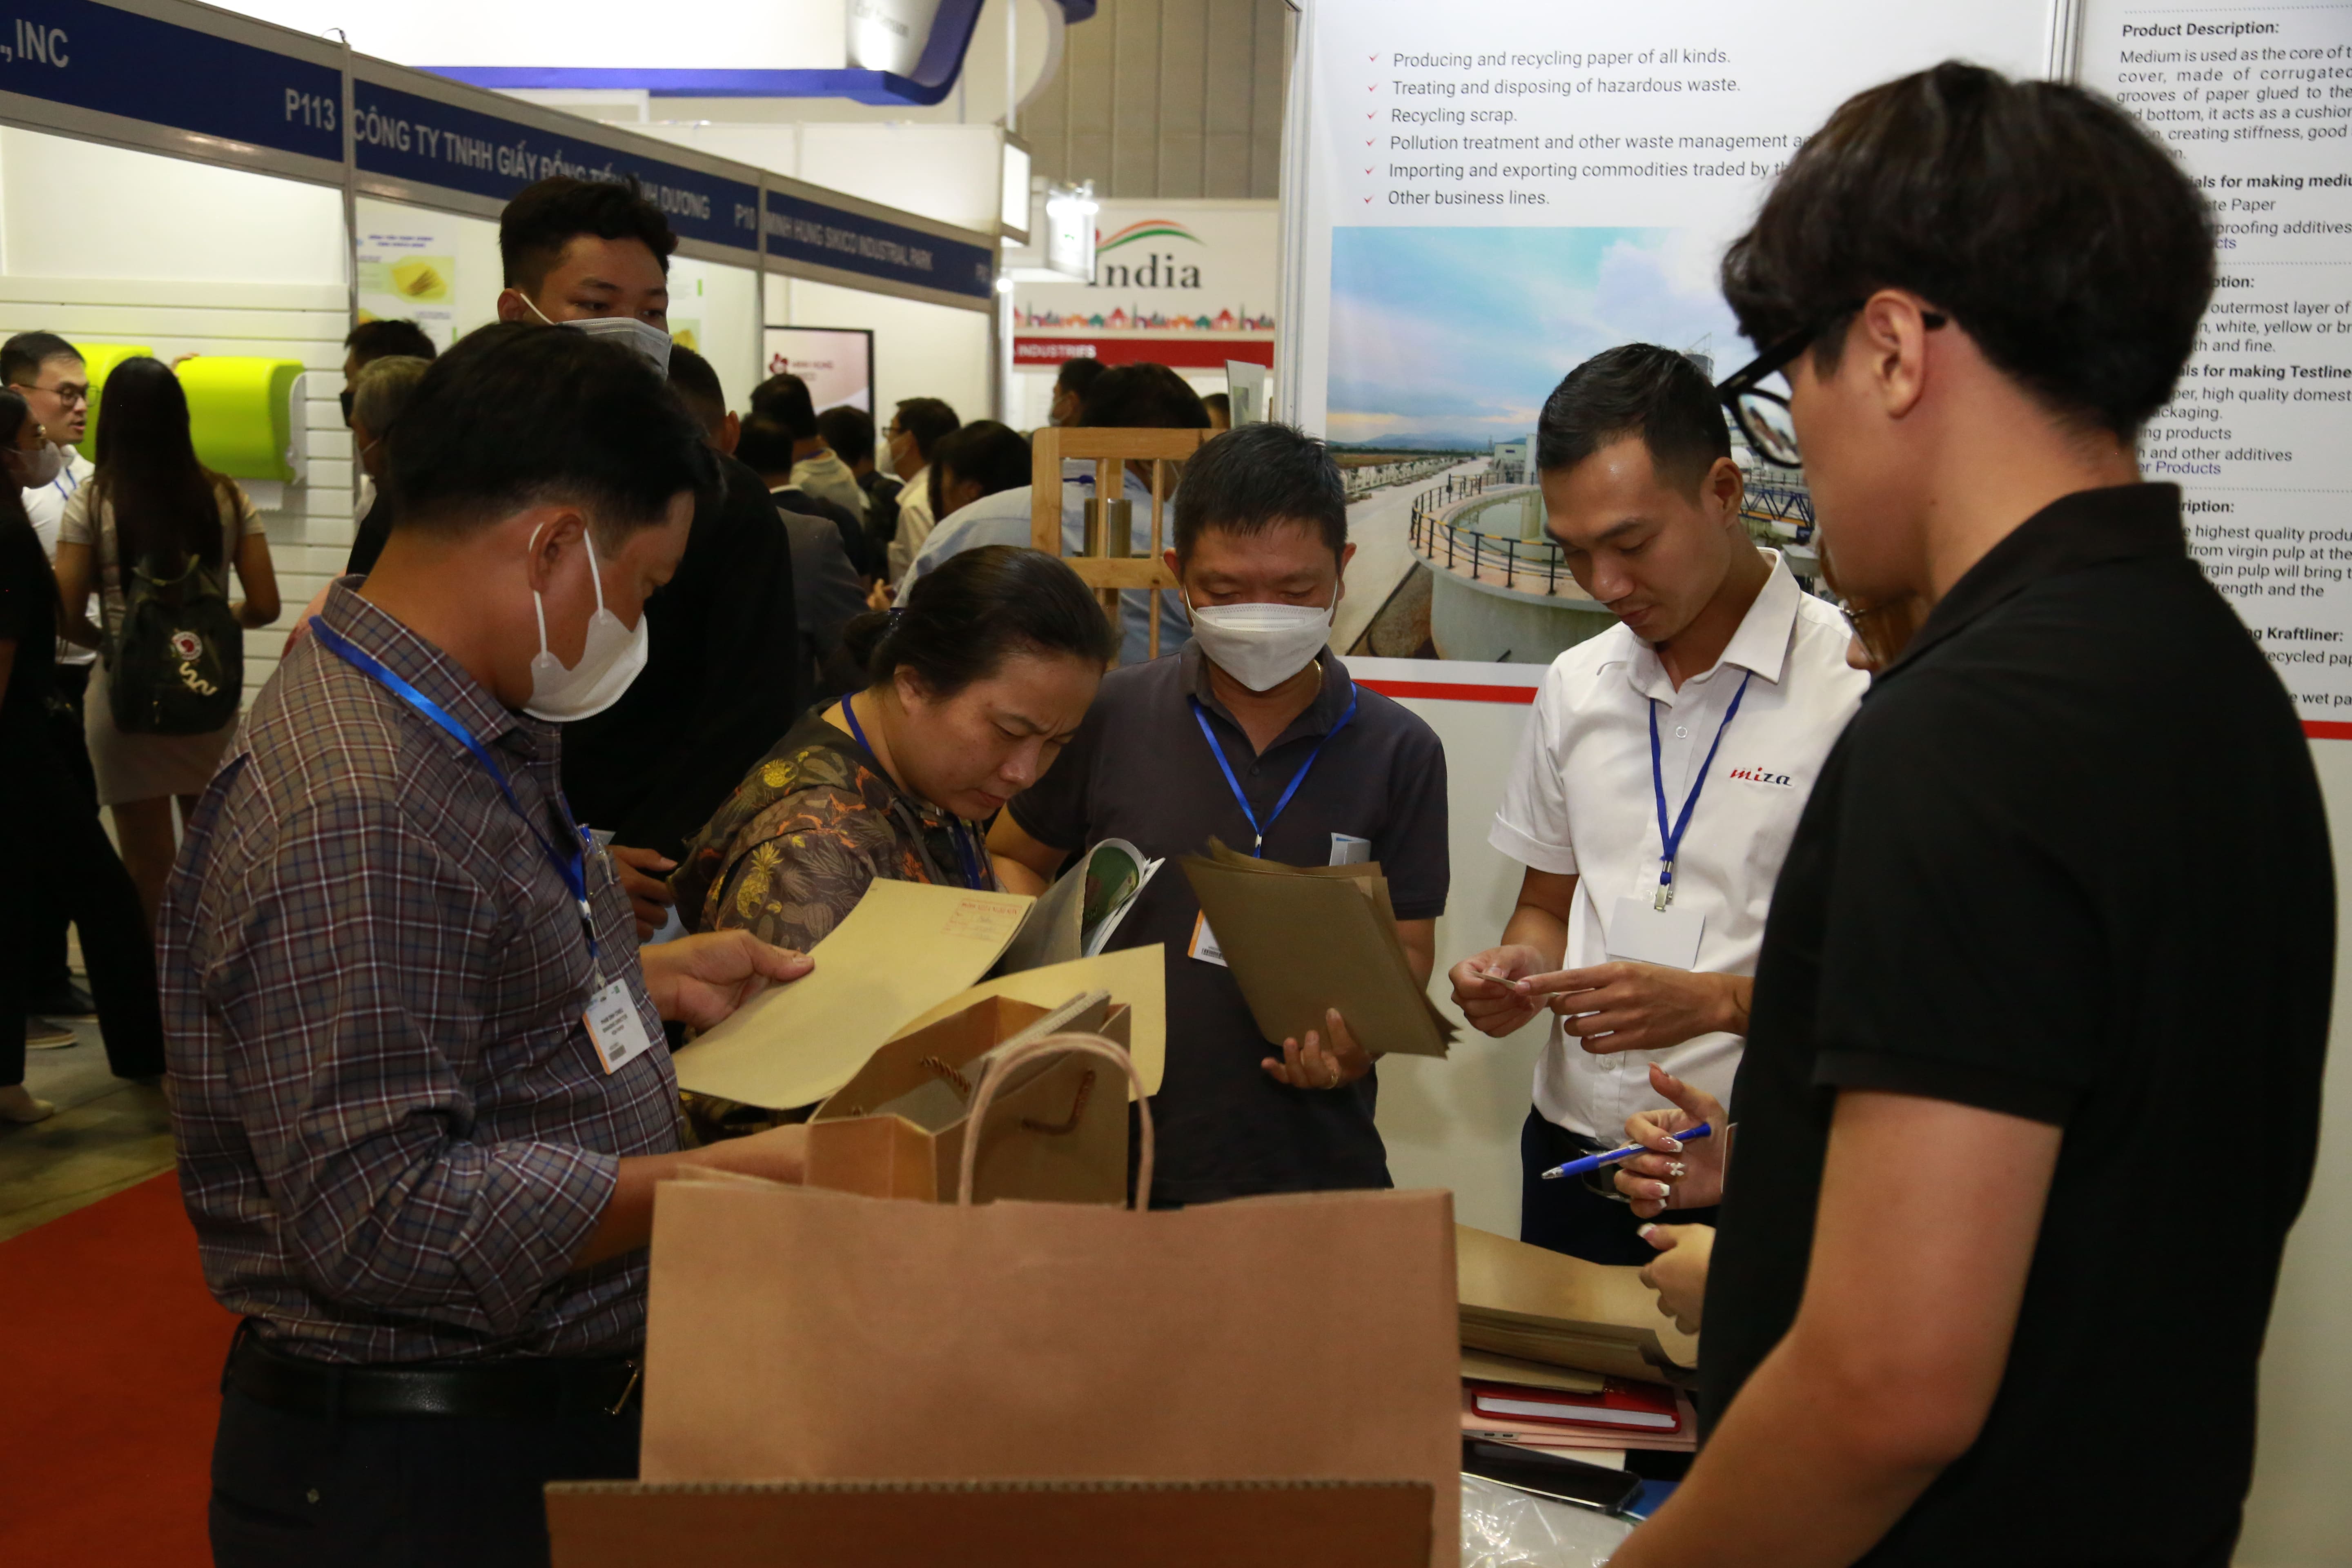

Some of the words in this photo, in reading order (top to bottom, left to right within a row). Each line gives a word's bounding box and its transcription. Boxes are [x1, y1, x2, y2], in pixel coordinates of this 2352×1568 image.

[2123, 23, 2182, 37] Product
[2187, 21, 2279, 38] Description:
[1394, 52, 1472, 70] Producing
[1477, 51, 1506, 66] and
[1511, 50, 1582, 69] recycling
[1587, 53, 1634, 68] paper
[1638, 49, 1655, 64] of
[1659, 49, 1677, 64] all
[1683, 48, 1730, 63] kinds.
[2120, 50, 2181, 63] Medium
[2185, 49, 2197, 62] is
[2201, 47, 2237, 62] used
[2241, 50, 2258, 61] as
[2262, 47, 2286, 60] the
[2290, 49, 2323, 60] core
[2327, 45, 2344, 59] of
[2118, 72, 2166, 84] cover,
[2177, 68, 2223, 82] made
[2233, 67, 2251, 81] of
[1392, 80, 1455, 98] Treating
[1461, 79, 1489, 94] and
[1494, 79, 1571, 97] disposing
[1576, 78, 1593, 93] of
[1598, 77, 1682, 93] hazardous
[1687, 78, 1740, 91] waste.
[2117, 91, 2175, 105] grooves
[2183, 87, 2200, 101] of
[2206, 90, 2250, 104] paper
[2256, 86, 2299, 103] glued
[2306, 87, 2322, 98] to
[285, 88, 336, 131] P113
[1392, 107, 1465, 126] Recycling
[1470, 111, 1517, 125] scrap.
[2147, 108, 2204, 122] bottom,
[2209, 107, 2218, 120] it
[2222, 108, 2254, 120] acts
[2259, 109, 2277, 119] as
[2281, 109, 2290, 119] a
[2168, 127, 2229, 143] creating
[2233, 125, 2303, 140] stiffness,
[2307, 124, 2348, 141] good
[354, 106, 410, 151] CÔNG
[415, 125, 440, 158] TY
[444, 132, 493, 171] TNHH
[497, 140, 538, 180] GIẤY
[1390, 135, 1458, 150] Pollution
[1463, 136, 1539, 149] treatment
[1545, 134, 1574, 149] and
[1579, 134, 1621, 149] other
[1625, 135, 1674, 148] waste
[1679, 134, 1787, 151] management
[1390, 163, 1464, 181] Importing
[1469, 162, 1497, 177] and
[1503, 163, 1577, 180] exporting
[1582, 161, 1688, 177] commodities
[1693, 161, 1745, 176] traded
[1751, 161, 1769, 180] by
[2221, 175, 2243, 188] for
[2247, 174, 2304, 190] making
[1388, 190, 1430, 205] Other
[1435, 190, 1504, 205] business
[1509, 189, 1549, 205] lines.
[2232, 198, 2276, 214] Paper
[2215, 221, 2278, 236] proofing
[2283, 220, 2352, 234] additives
[2211, 301, 2289, 314] outermost
[2294, 301, 2330, 317] layer
[2334, 301, 2351, 314] of
[2216, 320, 2259, 335] white,
[2264, 320, 2312, 336] yellow
[2316, 323, 2332, 334] or
[2212, 339, 2240, 352] and
[2245, 339, 2275, 352] fine.
[2203, 364, 2225, 377] for
[2229, 365, 2285, 381] making
[2290, 365, 2352, 378] Testline
[2203, 387, 2234, 403] high
[2238, 388, 2289, 404] quality
[2293, 388, 2352, 402] domest
[2154, 406, 2222, 421] ackaging.
[2166, 426, 2232, 441] products
[2150, 446, 2177, 459] and
[2182, 447, 2221, 460] other
[2225, 447, 2292, 461] additives
[2156, 460, 2221, 474] Products
[2182, 499, 2234, 514] ription:
[2195, 524, 2250, 541] highest
[2254, 527, 2305, 543] quality
[2309, 528, 2352, 543] produ
[2189, 543, 2223, 556] from
[2228, 545, 2268, 561] virgin
[2272, 546, 2305, 561] pulp
[2310, 548, 2324, 559] at
[2329, 547, 2352, 560] the
[2201, 563, 2233, 578] irgin
[2237, 564, 2270, 579] pulp
[2274, 564, 2299, 577] will
[2304, 565, 2342, 582] bring
[2268, 583, 2296, 596] and
[2300, 584, 2324, 597] the
[2267, 627, 2343, 641] Kraftliner:
[2267, 650, 2325, 666] ecycled
[2302, 693, 2329, 704] wet
[1730, 767, 1792, 786] miza
